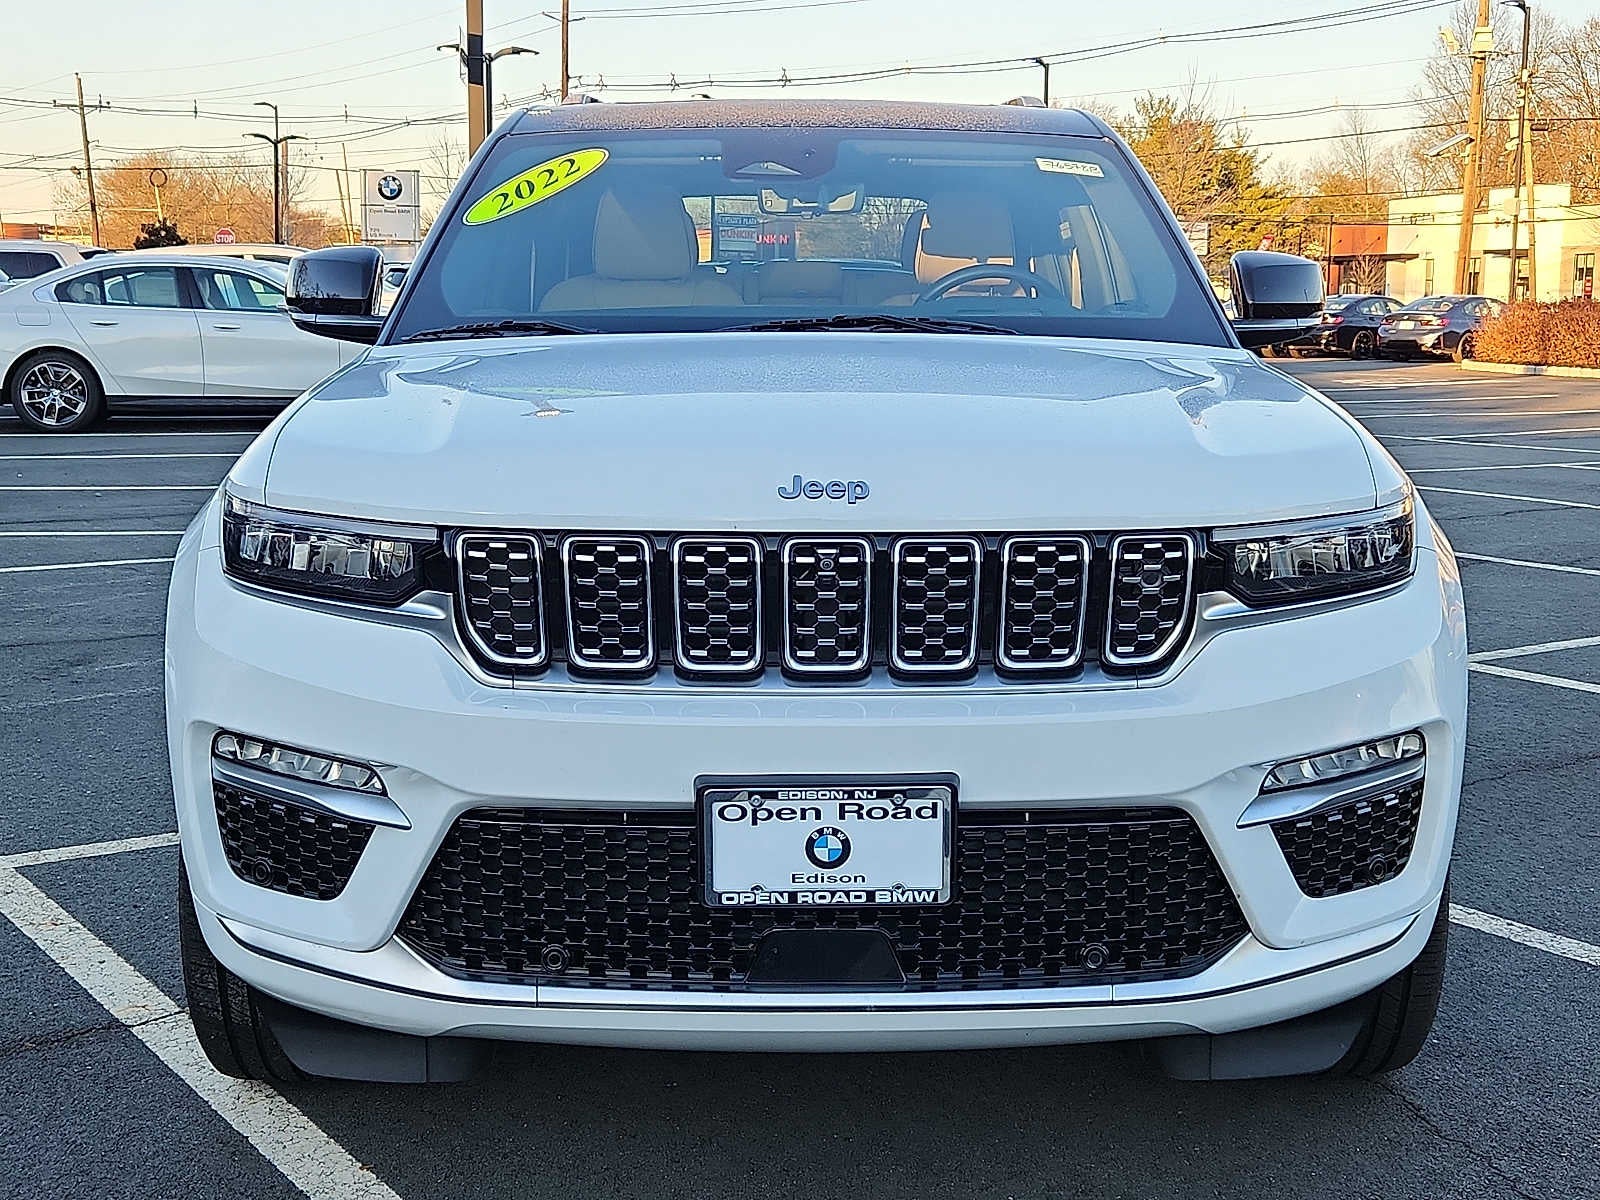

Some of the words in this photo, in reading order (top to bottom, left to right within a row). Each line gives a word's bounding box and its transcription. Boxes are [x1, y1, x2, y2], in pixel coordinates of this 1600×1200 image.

[491, 158, 581, 214] 2022
[216, 234, 234, 243] STOP
[777, 474, 870, 504] Jeep
[778, 790, 848, 800] EDISON,
[854, 790, 877, 800] NJ
[717, 804, 822, 826] Open
[838, 802, 938, 821] Road
[811, 827, 847, 841] BMW
[791, 872, 866, 884] Edison
[721, 892, 789, 904] OPEN
[797, 892, 866, 904] ROAD
[875, 891, 936, 904] BMW
